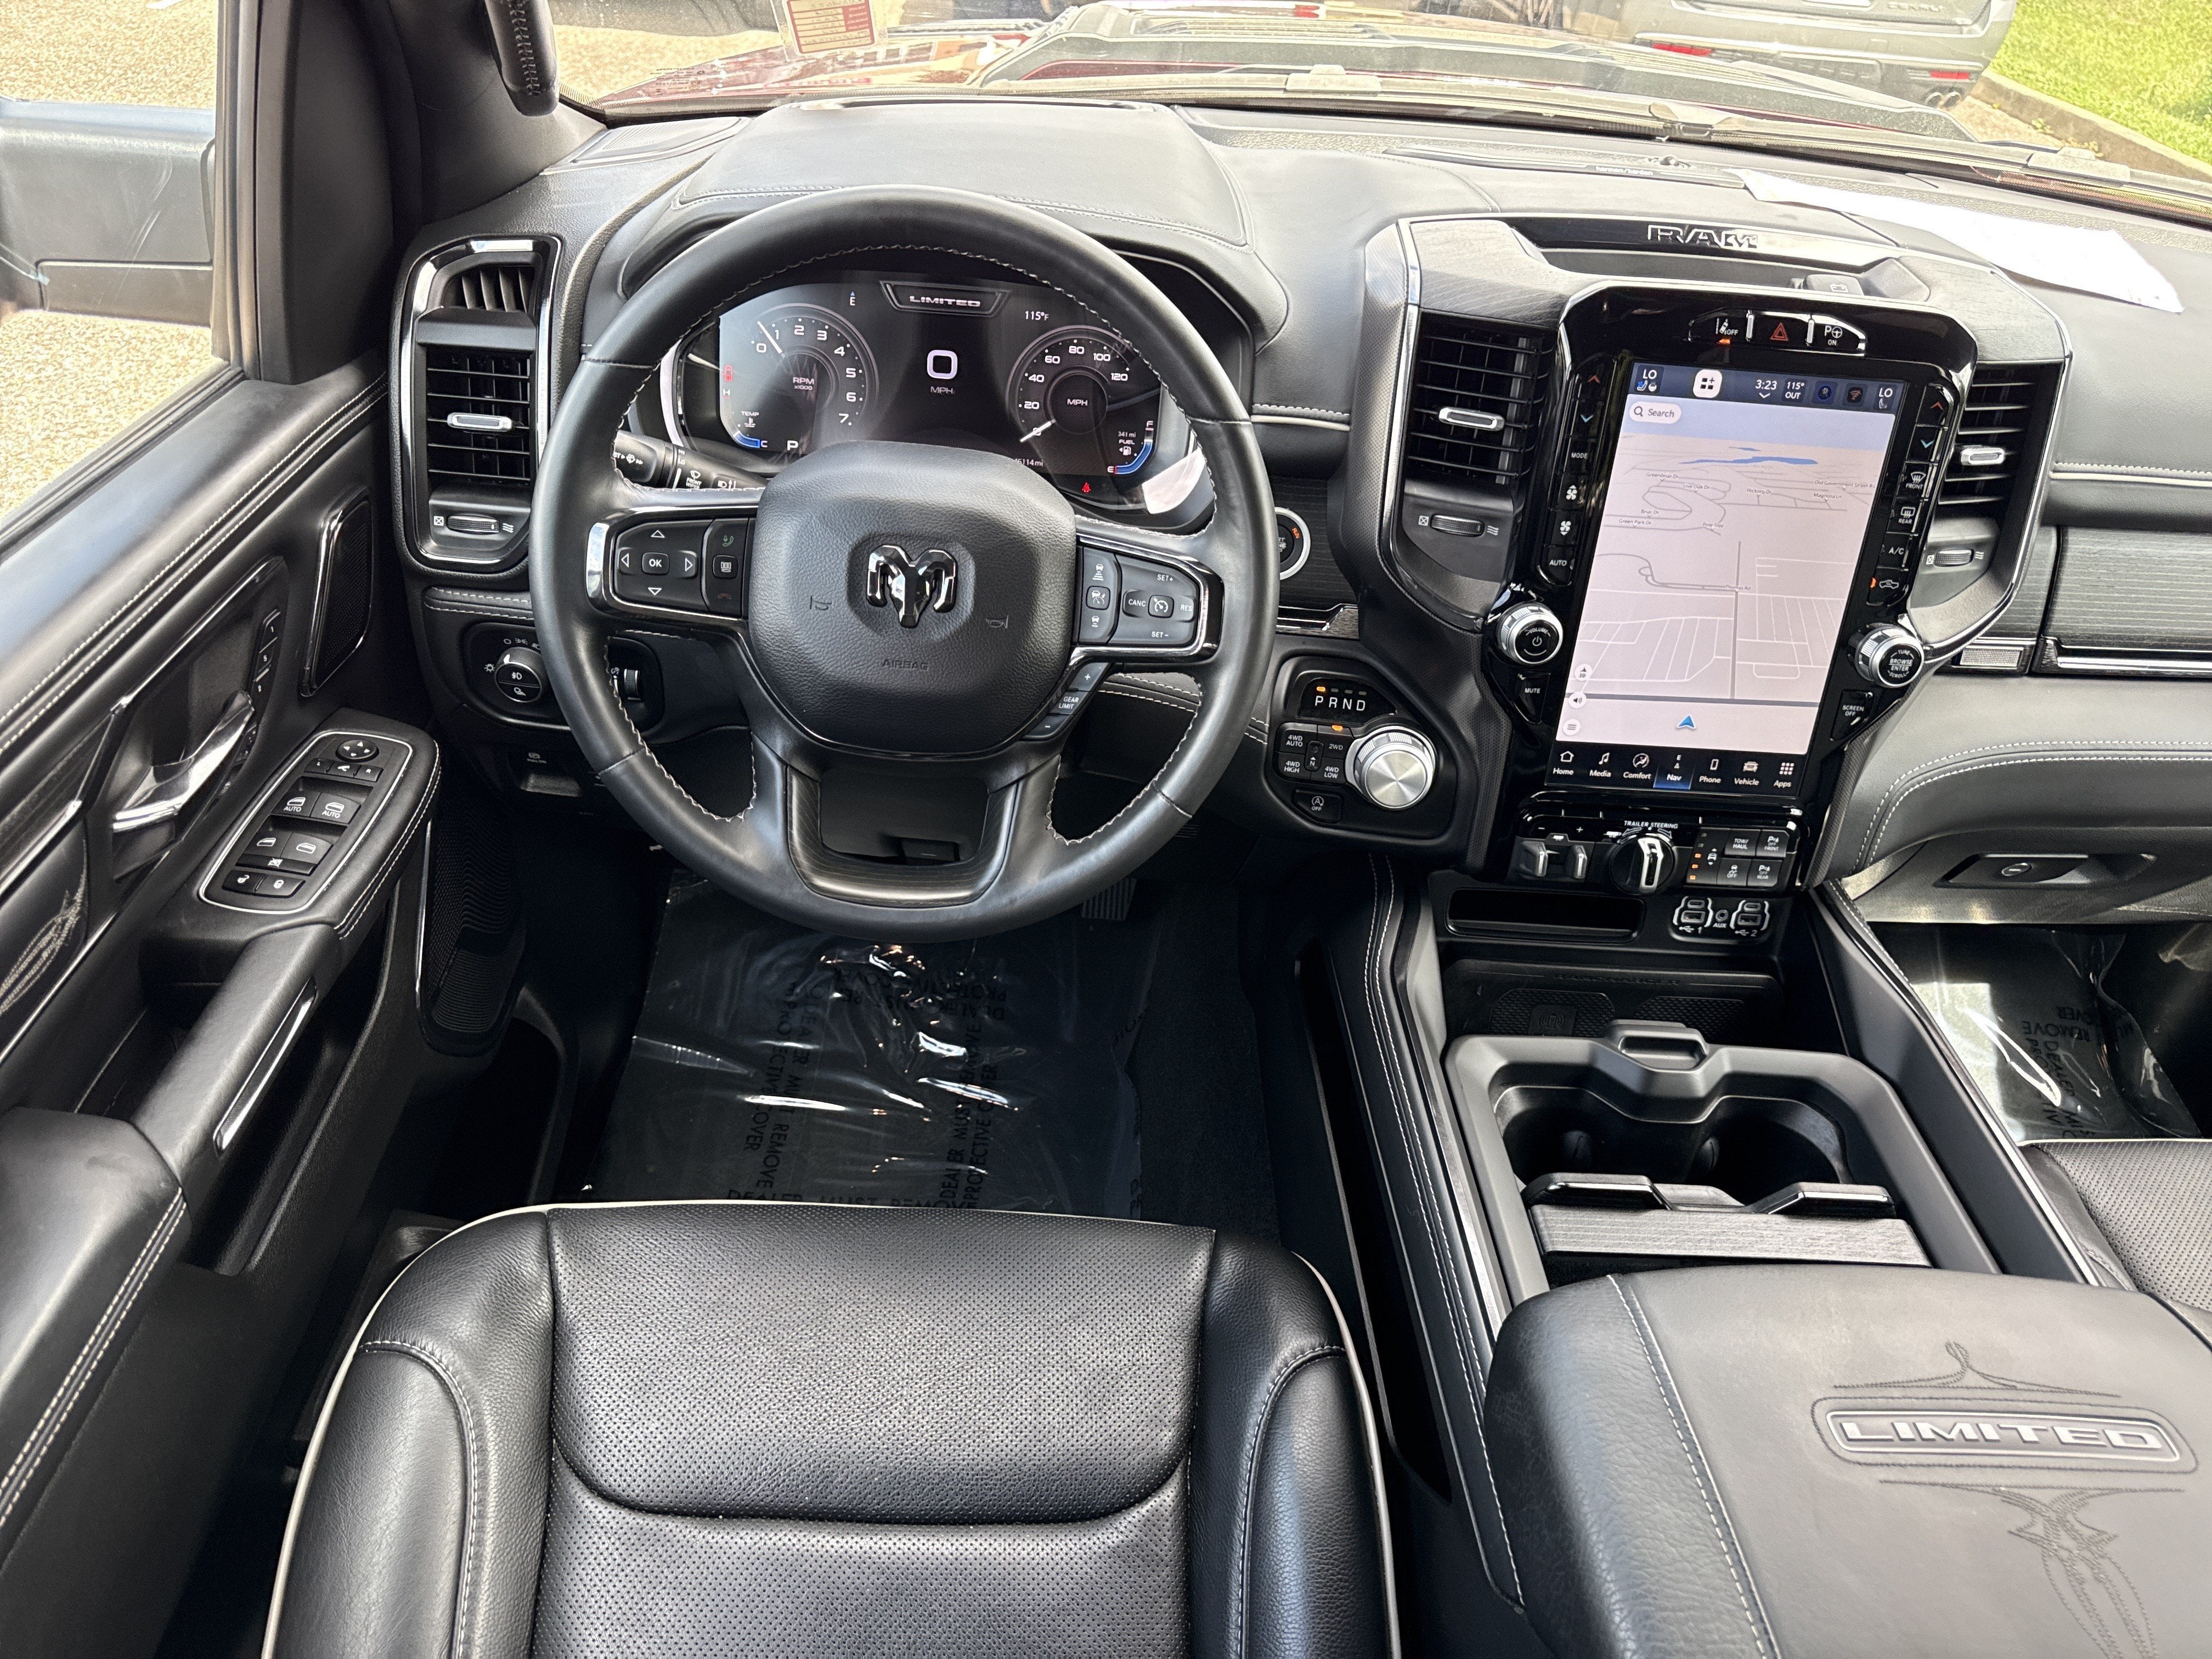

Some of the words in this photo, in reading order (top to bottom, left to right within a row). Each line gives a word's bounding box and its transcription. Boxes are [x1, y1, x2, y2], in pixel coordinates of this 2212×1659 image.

[1647, 224, 1758, 250] RAM
[850, 297, 856, 306] E
[910, 296, 980, 307] LIMITED
[794, 325, 804, 335] 2
[775, 330, 780, 340] 1
[817, 330, 827, 340] 3
[757, 343, 766, 353] 0
[834, 347, 845, 356] 4
[1069, 346, 1085, 354] 80
[1045, 356, 1060, 364] 60
[1093, 353, 1111, 362] 100
[927, 349, 958, 380] 0
[846, 368, 856, 378] 5
[1110, 373, 1128, 381] 120
[1642, 369, 1657, 380] LO
[1028, 374, 1045, 382] 40
[1755, 380, 1778, 390] 3:23
[1785, 391, 1801, 399] OUT
[1878, 387, 1893, 397] LO
[846, 392, 856, 402] 6
[1024, 401, 1039, 409] 20
[1067, 398, 1088, 407] MPH
[1647, 409, 1674, 418] Search
[838, 414, 849, 423] 7
[787, 441, 798, 450] P
[686, 477, 702, 486] FRONT
[649, 558, 663, 568] OK
[1128, 599, 1146, 607] CANC
[882, 659, 929, 670] AIRBAG
[1314, 695, 1324, 707] P
[1329, 697, 1338, 708] R
[1342, 698, 1352, 710] N
[1356, 699, 1365, 711] D
[1553, 767, 1574, 776] Home
[1589, 769, 1611, 778] Media
[1623, 770, 1651, 780] Comfort
[1667, 774, 1681, 782] Nav
[1699, 776, 1721, 785] Phone
[1734, 777, 1759, 787] Vehicle
[1774, 780, 1792, 788] Apps
[321, 810, 341, 819] AUTO
[760, 1001, 798, 1095] PROECTIVE
[952, 1099, 971, 1140] MUST
[757, 1124, 790, 1189] REMOVE
[1839, 1421, 2163, 1450] LIMITED
